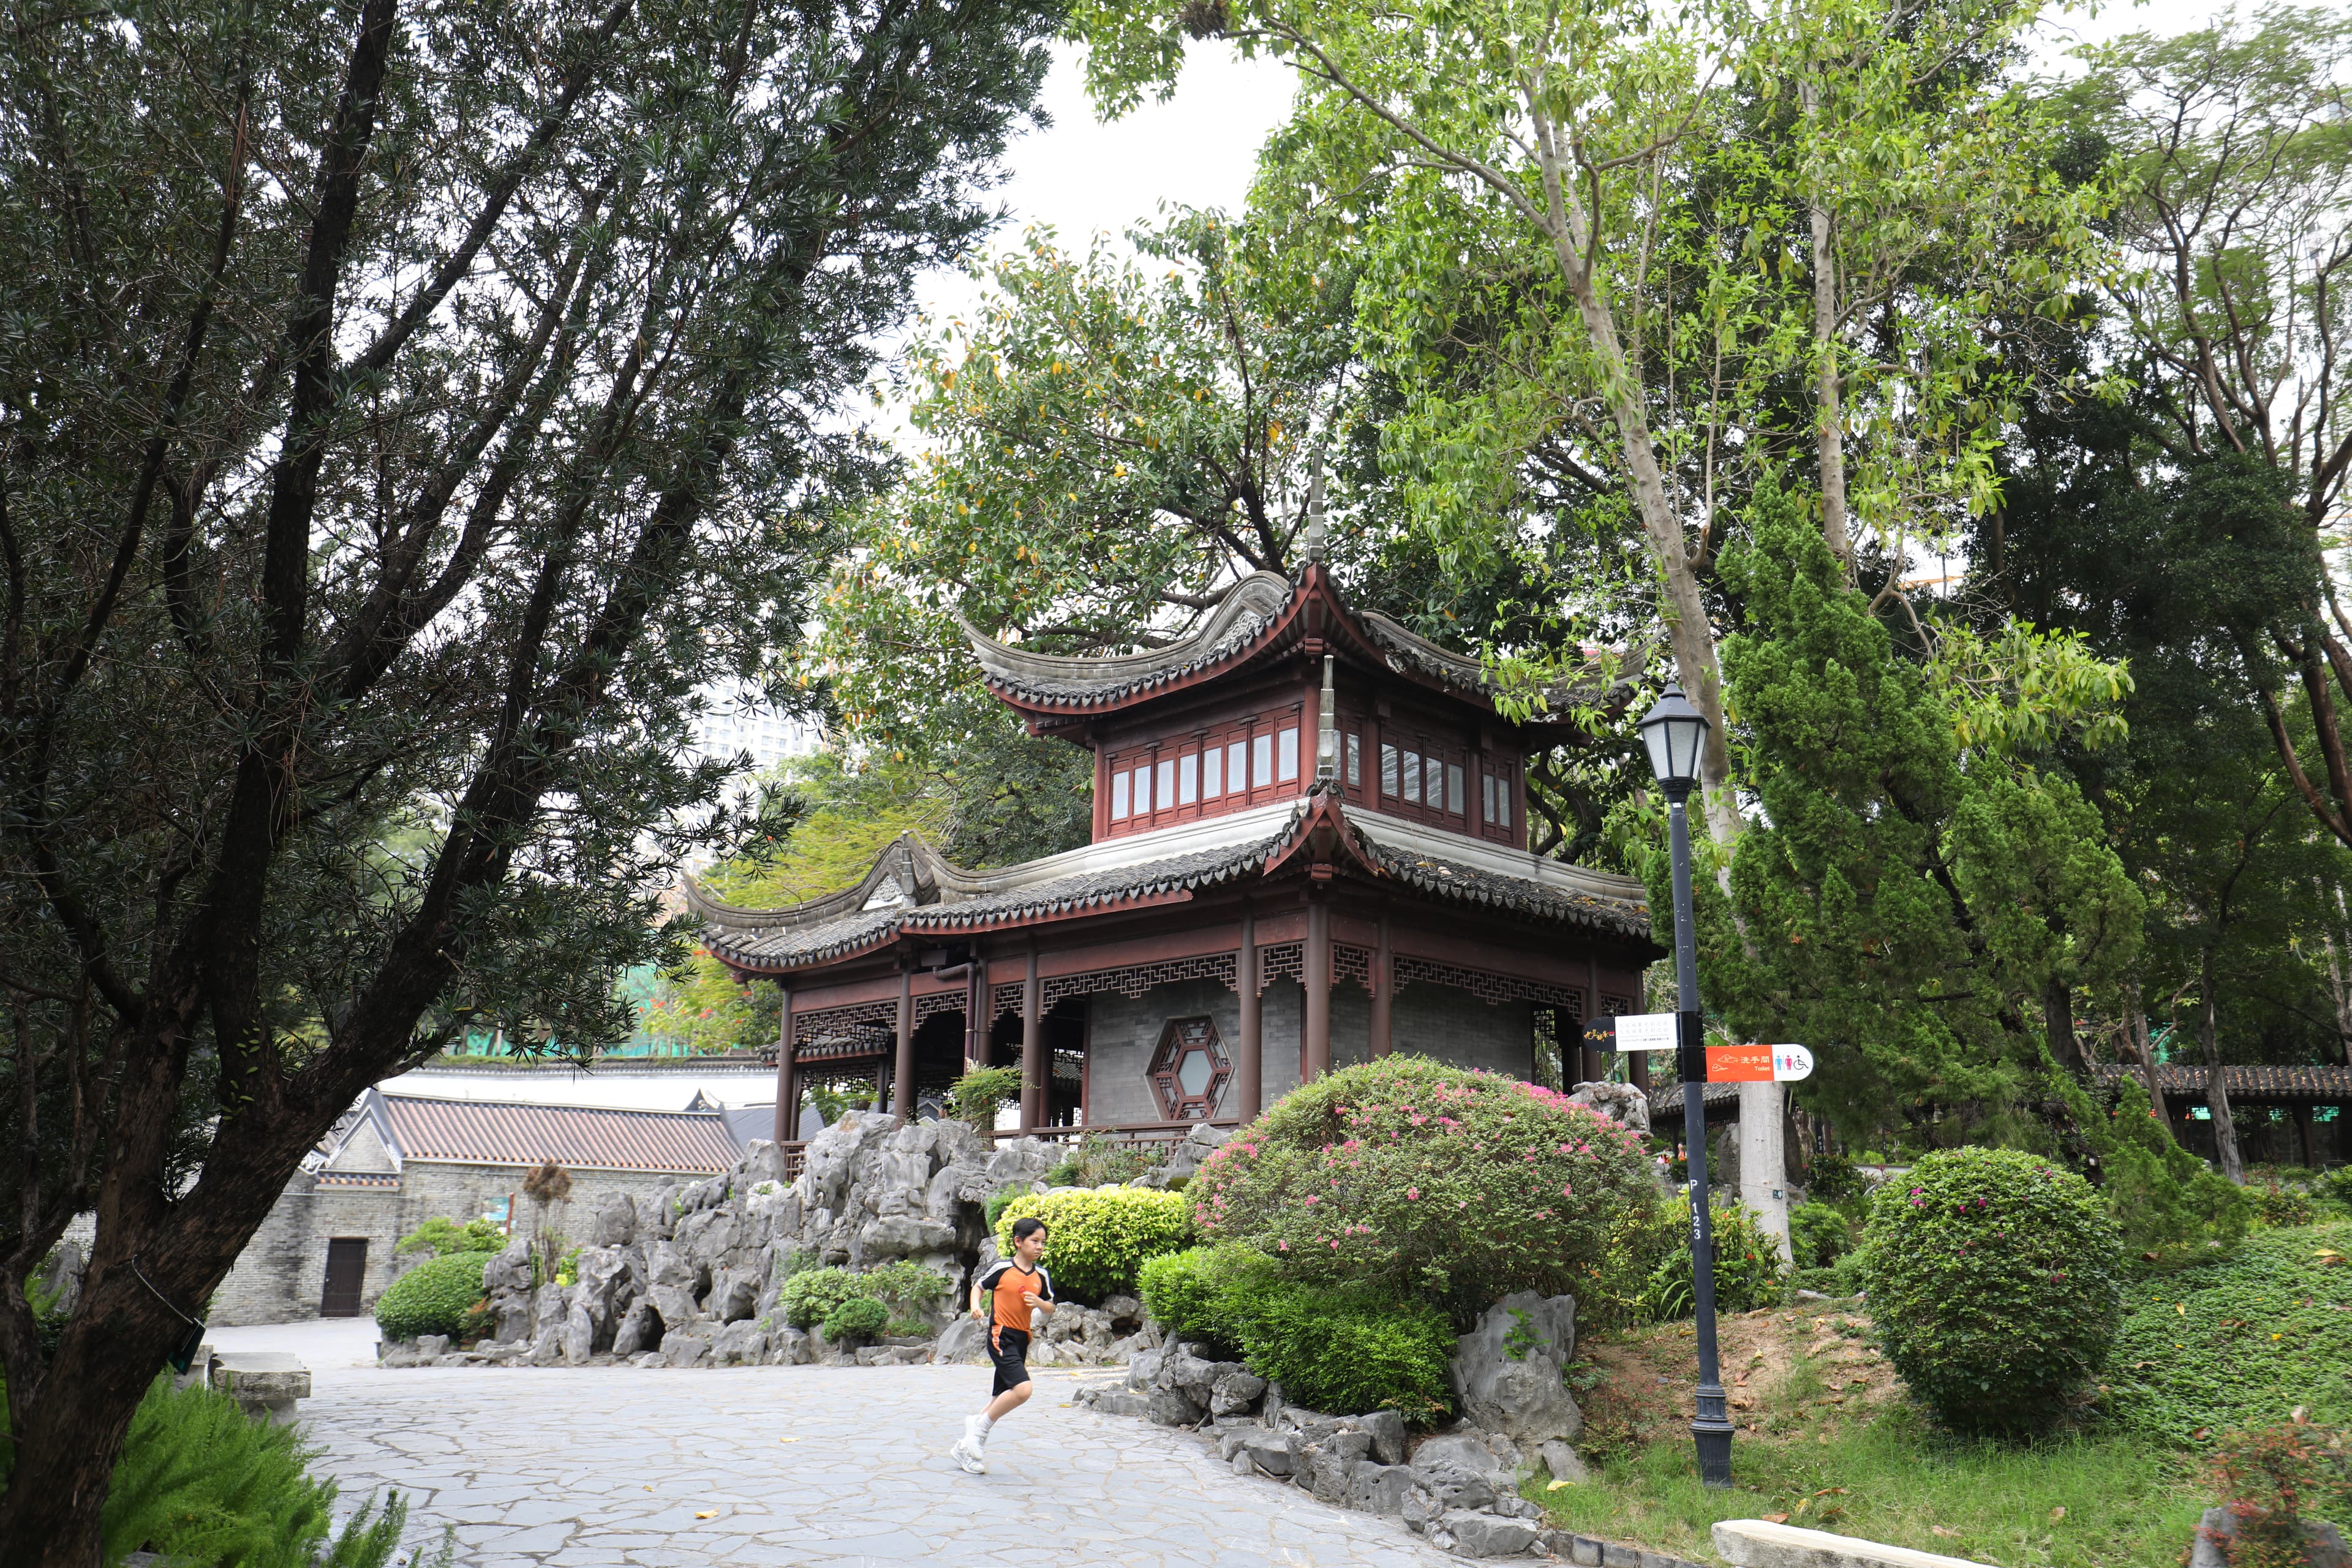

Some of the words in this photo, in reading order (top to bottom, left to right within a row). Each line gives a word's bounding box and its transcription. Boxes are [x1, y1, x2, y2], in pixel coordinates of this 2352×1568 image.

[1740, 1055, 1770, 1064] 洗手間
[1690, 1179, 1698, 1191] P
